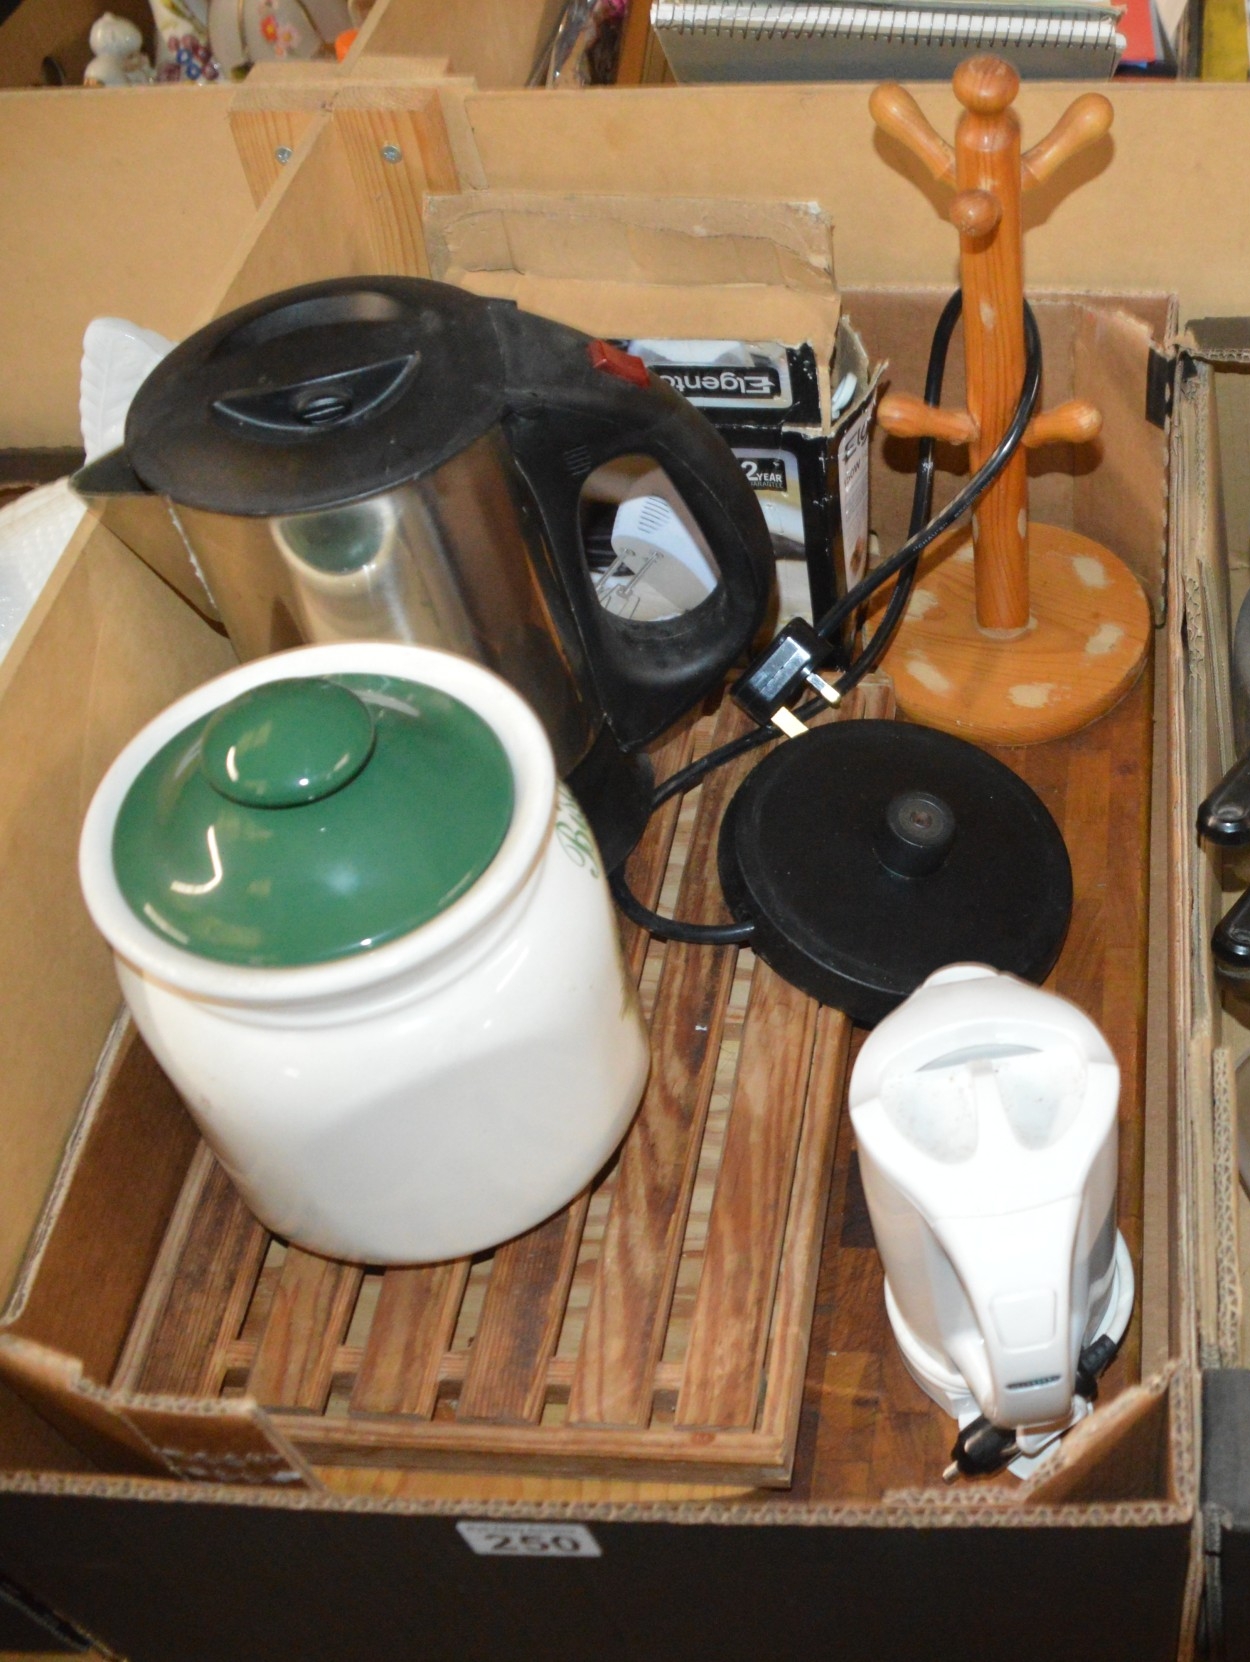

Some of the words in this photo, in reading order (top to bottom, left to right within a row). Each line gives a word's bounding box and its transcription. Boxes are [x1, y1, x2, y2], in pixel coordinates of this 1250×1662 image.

[740, 460, 759, 482] 2
[756, 472, 783, 484] YEAR
[484, 1534, 581, 1552] 250
